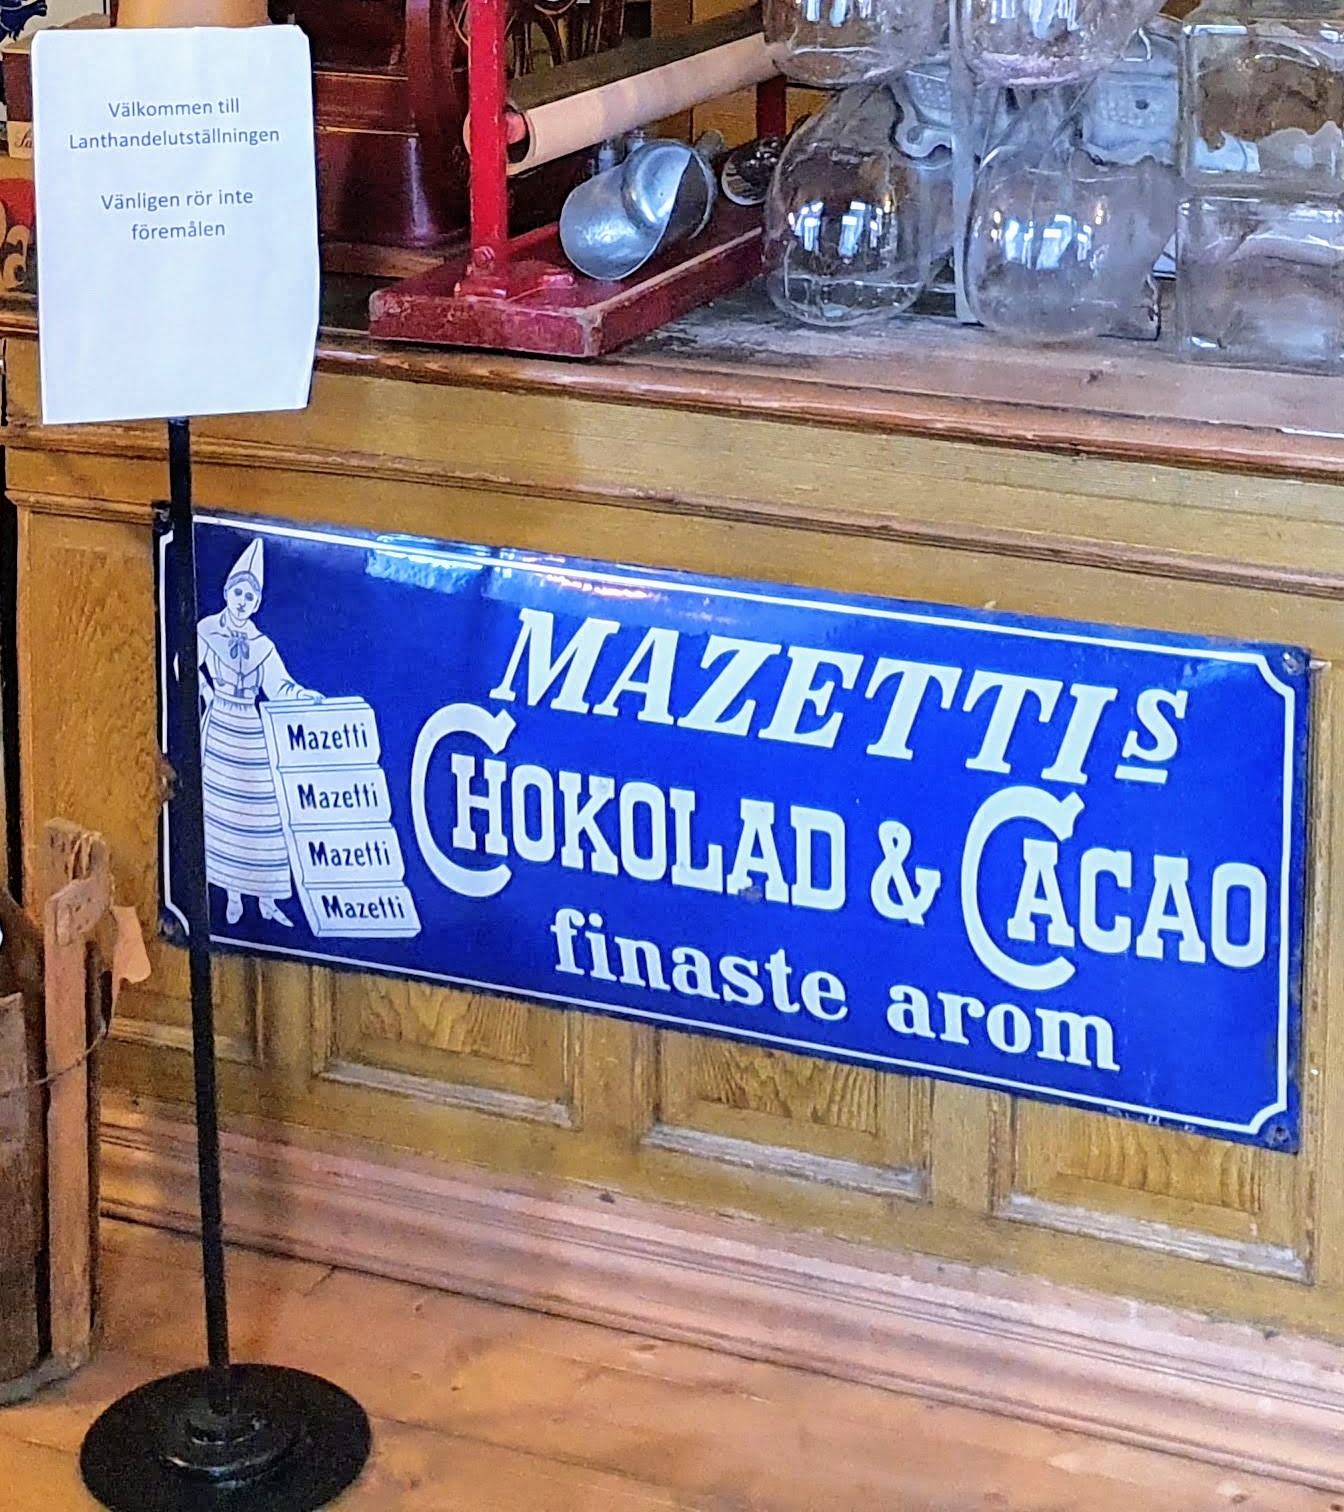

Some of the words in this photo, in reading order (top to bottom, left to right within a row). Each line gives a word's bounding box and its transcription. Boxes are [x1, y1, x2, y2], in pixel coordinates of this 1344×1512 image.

[108, 99, 212, 120] Välkommen
[217, 97, 242, 116] till
[68, 124, 282, 152] Lanthandelutställningen
[100, 191, 181, 215] Vänligen
[186, 191, 212, 209] rör
[218, 188, 255, 206] inte
[131, 219, 227, 242] föremålen
[286, 720, 370, 752] Mazetti
[297, 781, 380, 811] Mazetti
[307, 838, 393, 870] Mazetti
[410, 702, 847, 912] CHOKOLAD
[870, 820, 942, 926] &
[960, 785, 1269, 991] CACAO
[321, 893, 407, 922] Mazetti
[549, 907, 850, 1023] finaste
[886, 981, 1122, 1073] arom
